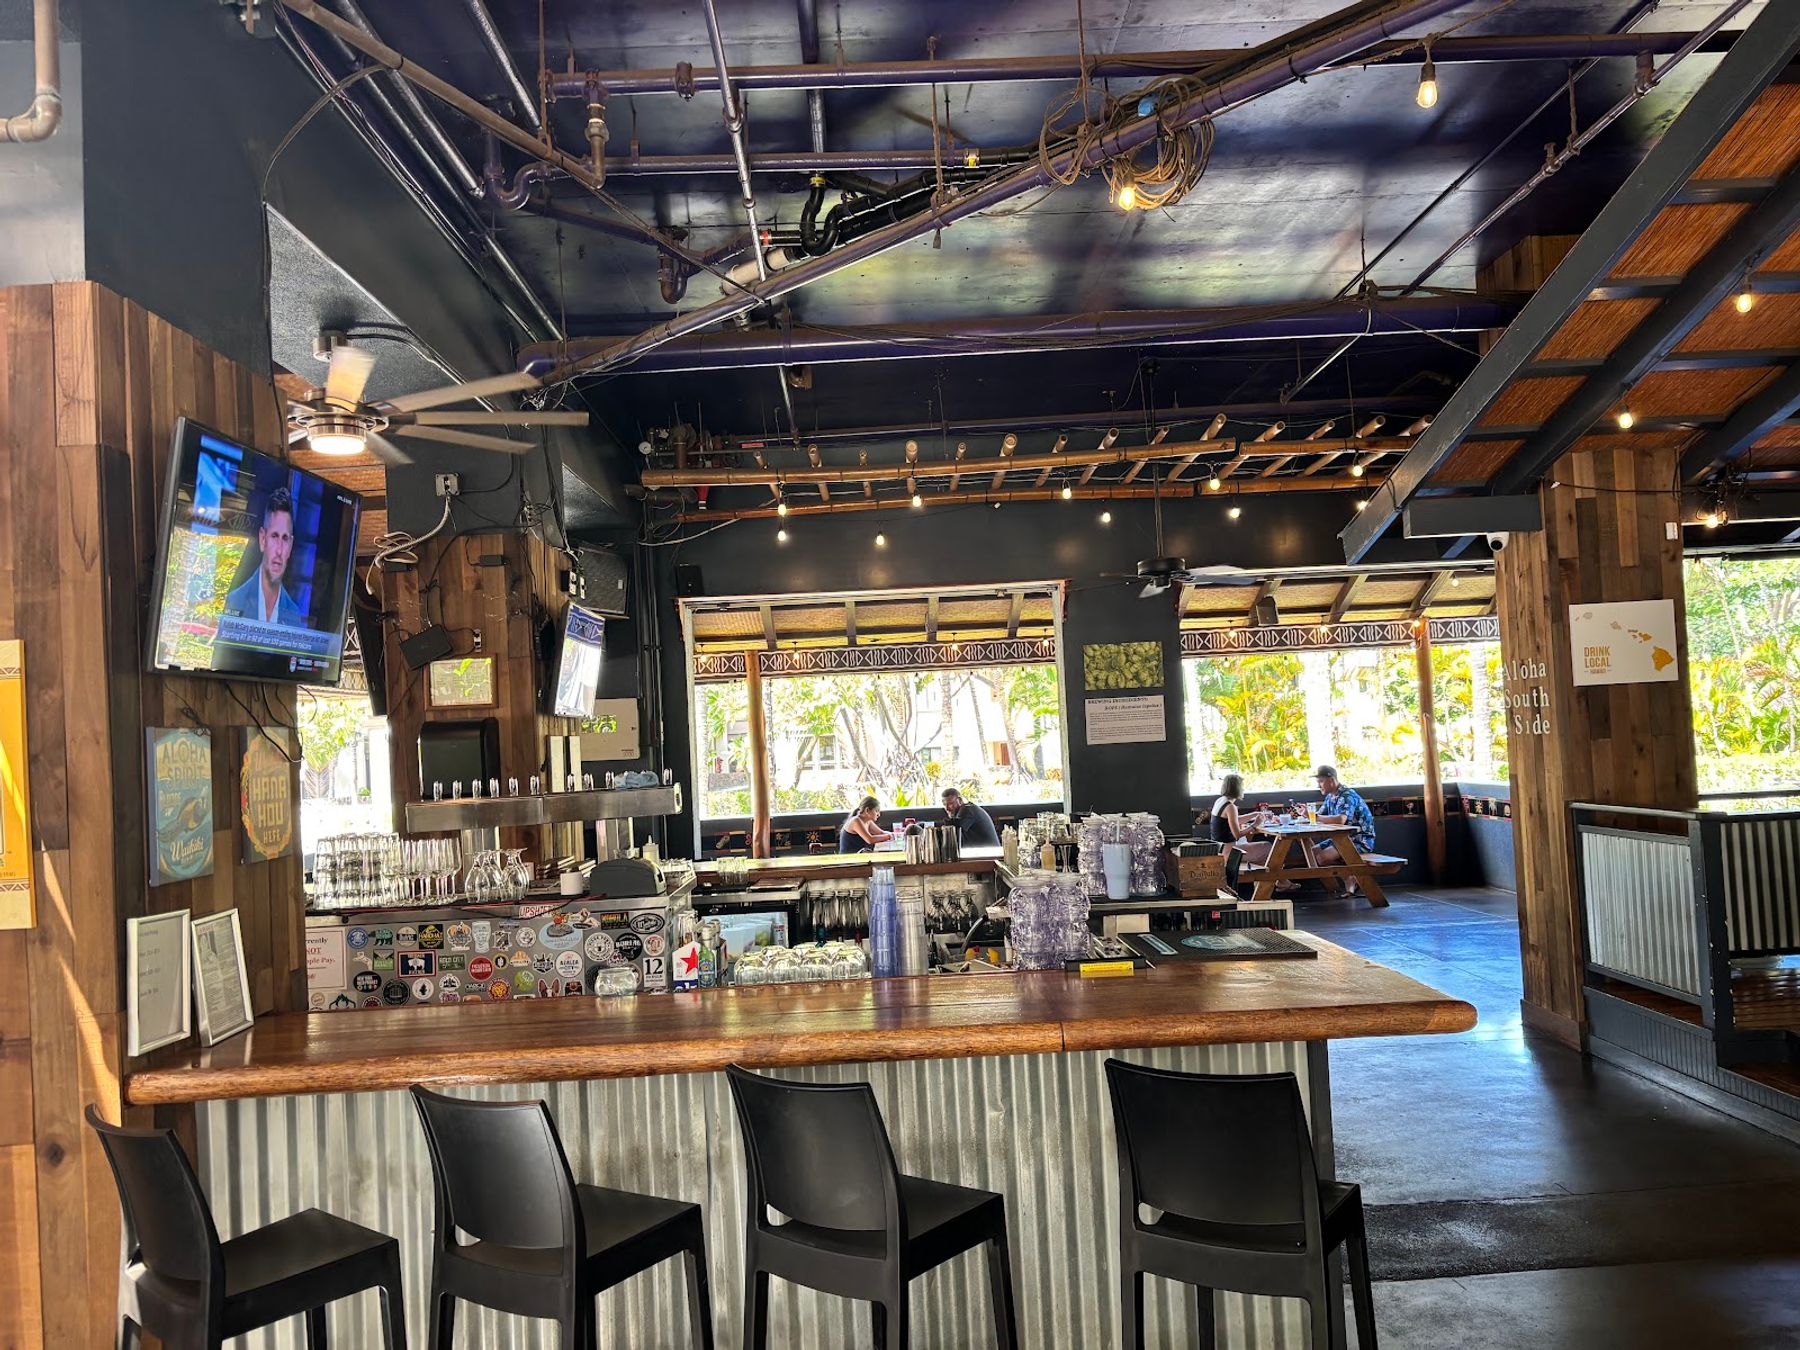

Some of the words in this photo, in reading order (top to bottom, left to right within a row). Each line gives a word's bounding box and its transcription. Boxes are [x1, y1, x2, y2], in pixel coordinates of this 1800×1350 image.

[1584, 646, 1610, 657] DRINK
[1585, 657, 1612, 668] LOCAL
[1503, 658, 1546, 681] Aloha
[1504, 686, 1550, 709] South
[1515, 713, 1551, 735] Side
[162, 740, 208, 764] ALOHA
[252, 775, 288, 800] HANA
[257, 802, 284, 828] HOU
[645, 958, 663, 975] 12
